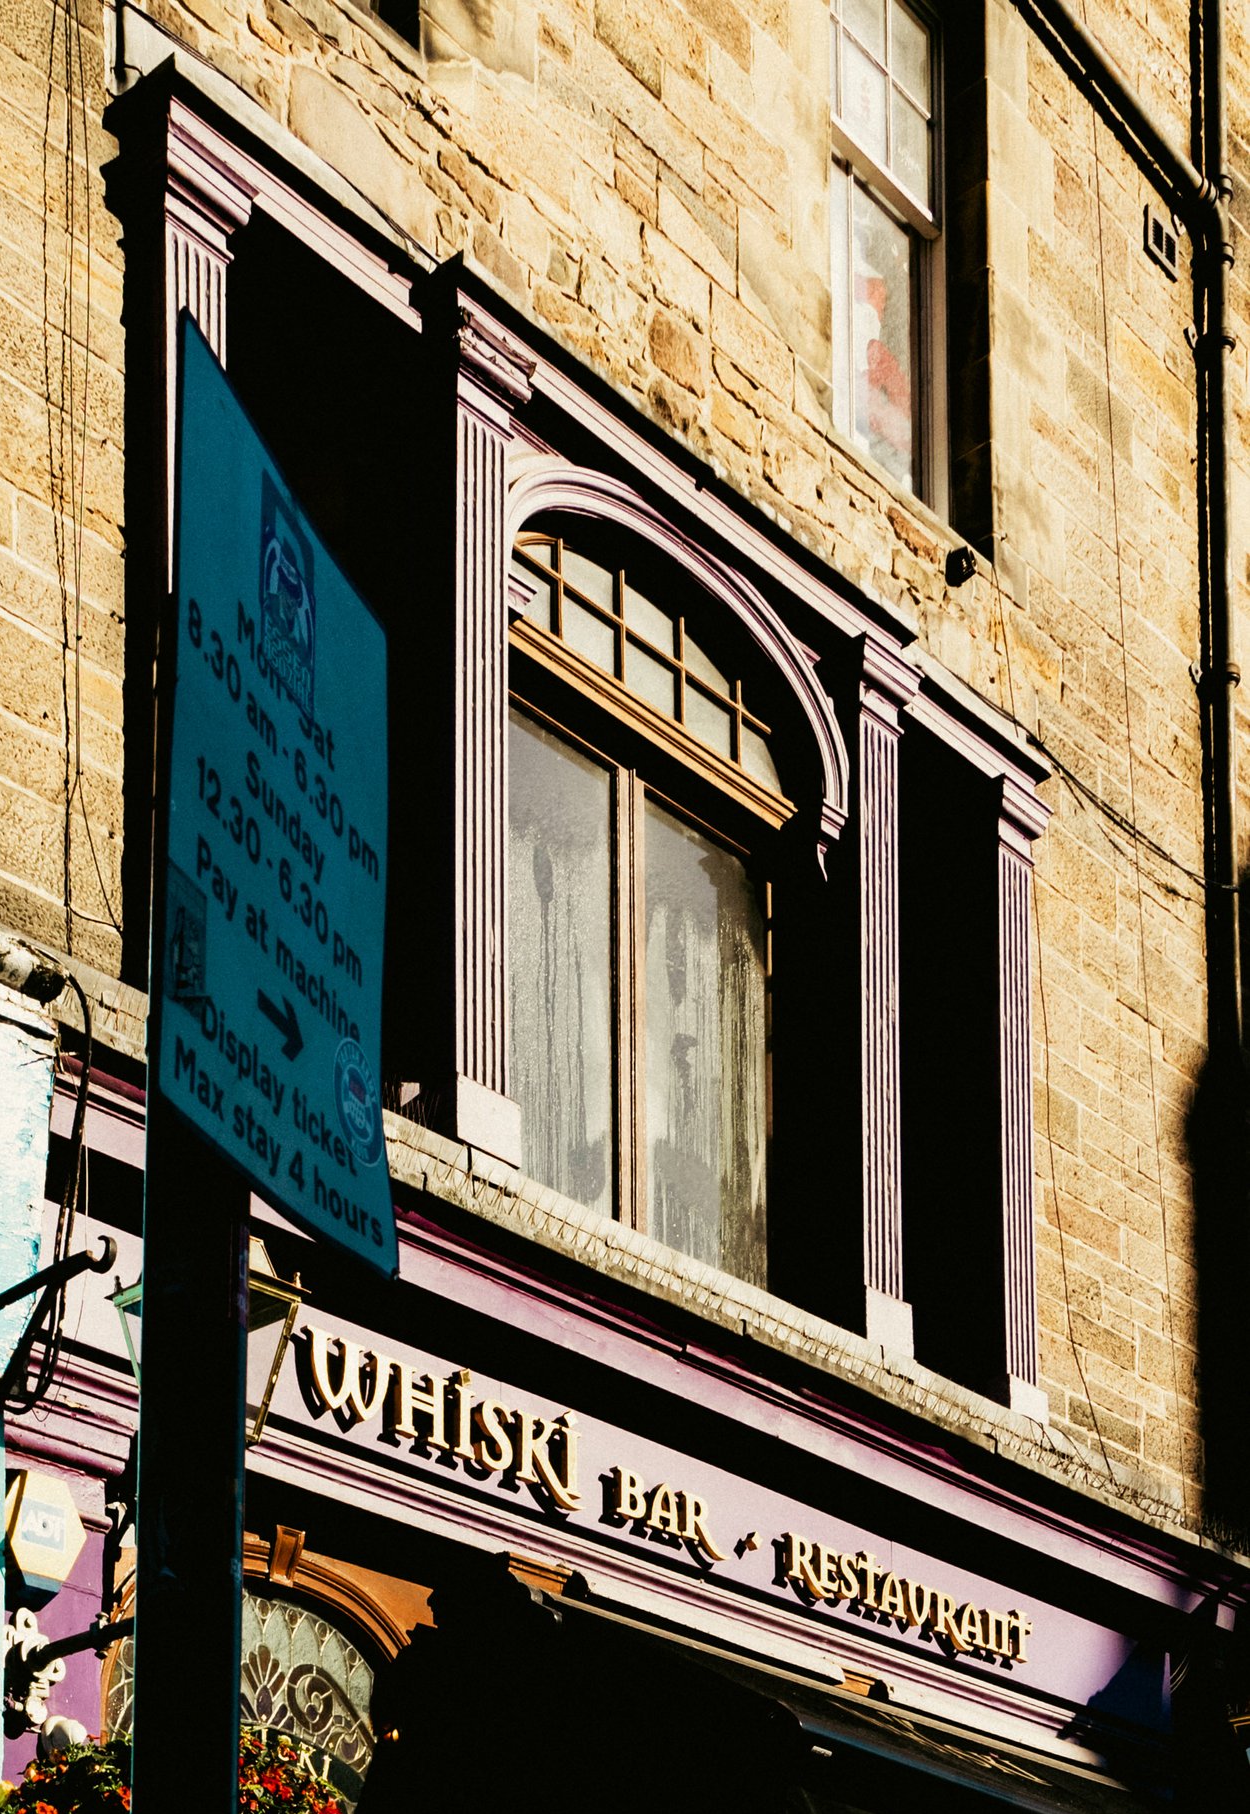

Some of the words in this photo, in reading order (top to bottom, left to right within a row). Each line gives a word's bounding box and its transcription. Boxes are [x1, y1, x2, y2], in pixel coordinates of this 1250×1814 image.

[188, 598, 241, 703] 8.30
[246, 690, 278, 756] am
[293, 748, 344, 838] 6.30
[349, 823, 379, 882] pm
[245, 751, 326, 885] Sunday
[197, 755, 261, 865] 12.30
[278, 857, 330, 945] 6.30
[333, 928, 363, 989] pm
[197, 834, 238, 921] Pay
[245, 901, 268, 956] at
[275, 937, 360, 1044] machine
[175, 1036, 225, 1122] Max
[232, 1104, 282, 1181] stay
[288, 1151, 307, 1193] 4
[313, 1163, 384, 1248] hours
[199, 996, 284, 1116] Display
[291, 1086, 358, 1177] ticket
[606, 1465, 732, 1562] BAR
